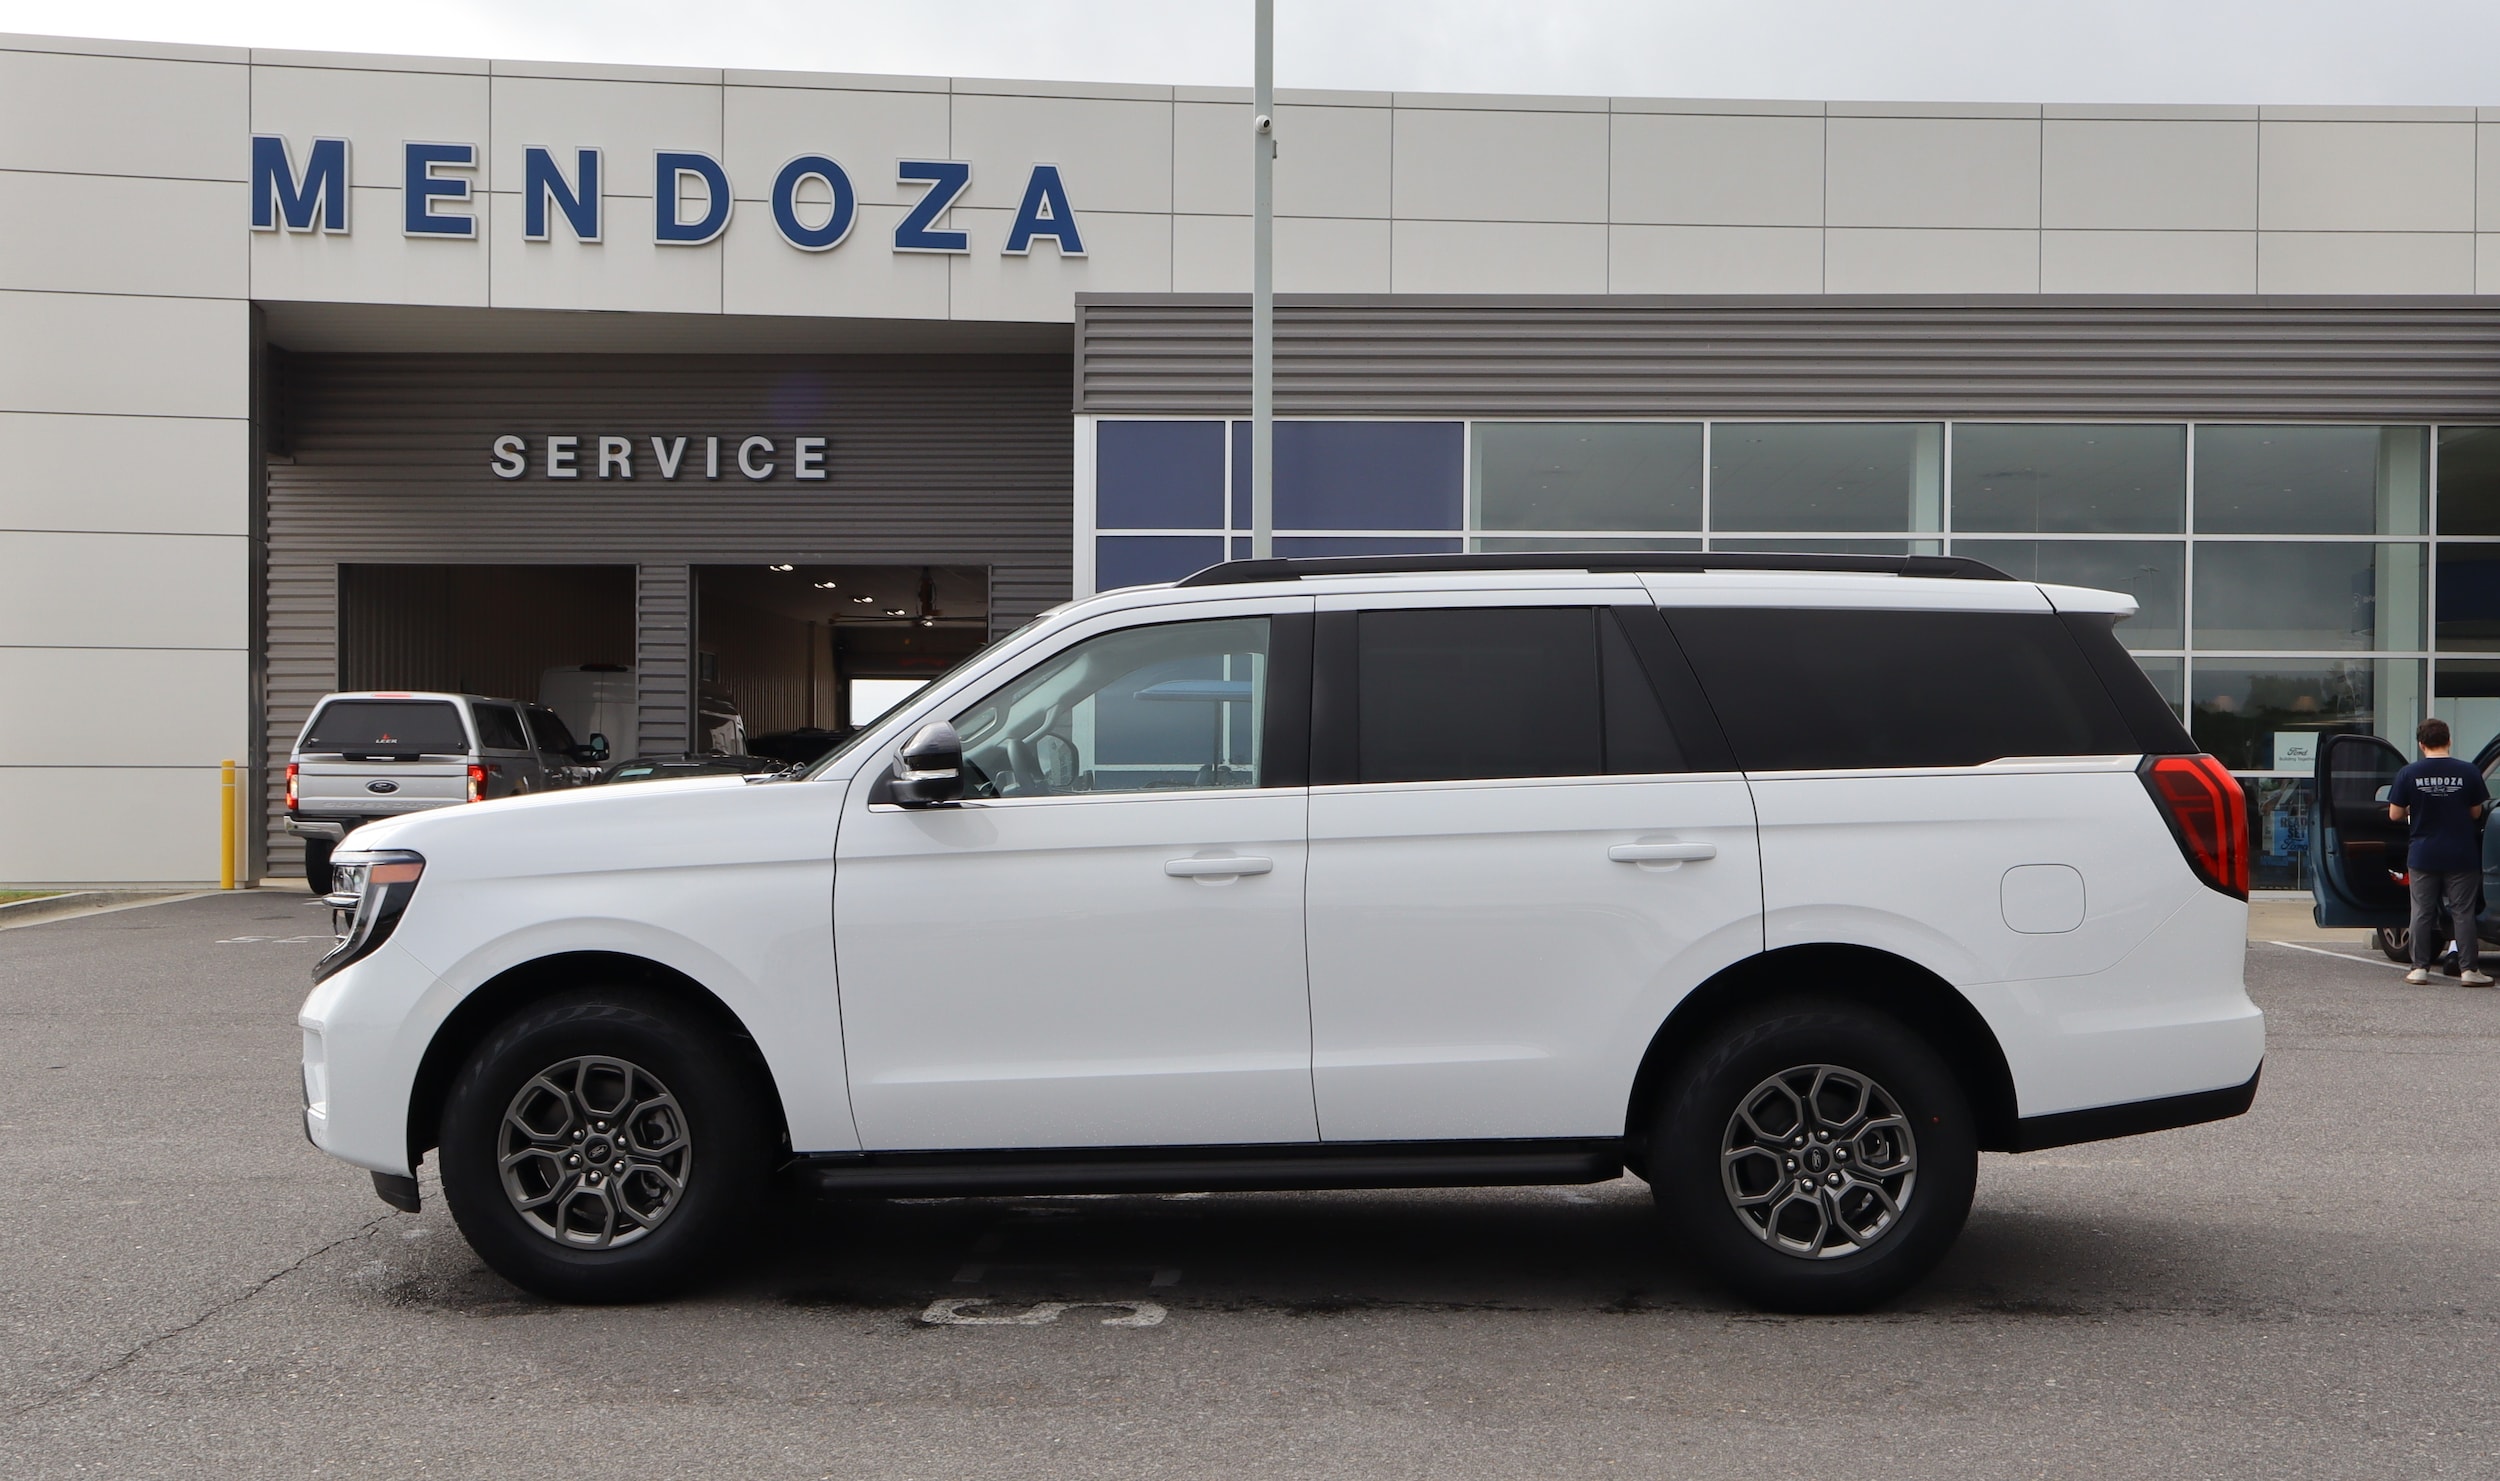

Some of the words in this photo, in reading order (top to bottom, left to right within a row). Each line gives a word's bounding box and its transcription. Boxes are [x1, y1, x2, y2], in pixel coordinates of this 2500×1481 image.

[249, 133, 1089, 257] MENDOZA
[490, 434, 831, 481] SERVICE
[2287, 746, 2309, 756] Ford
[2415, 777, 2464, 787] MENDOZA
